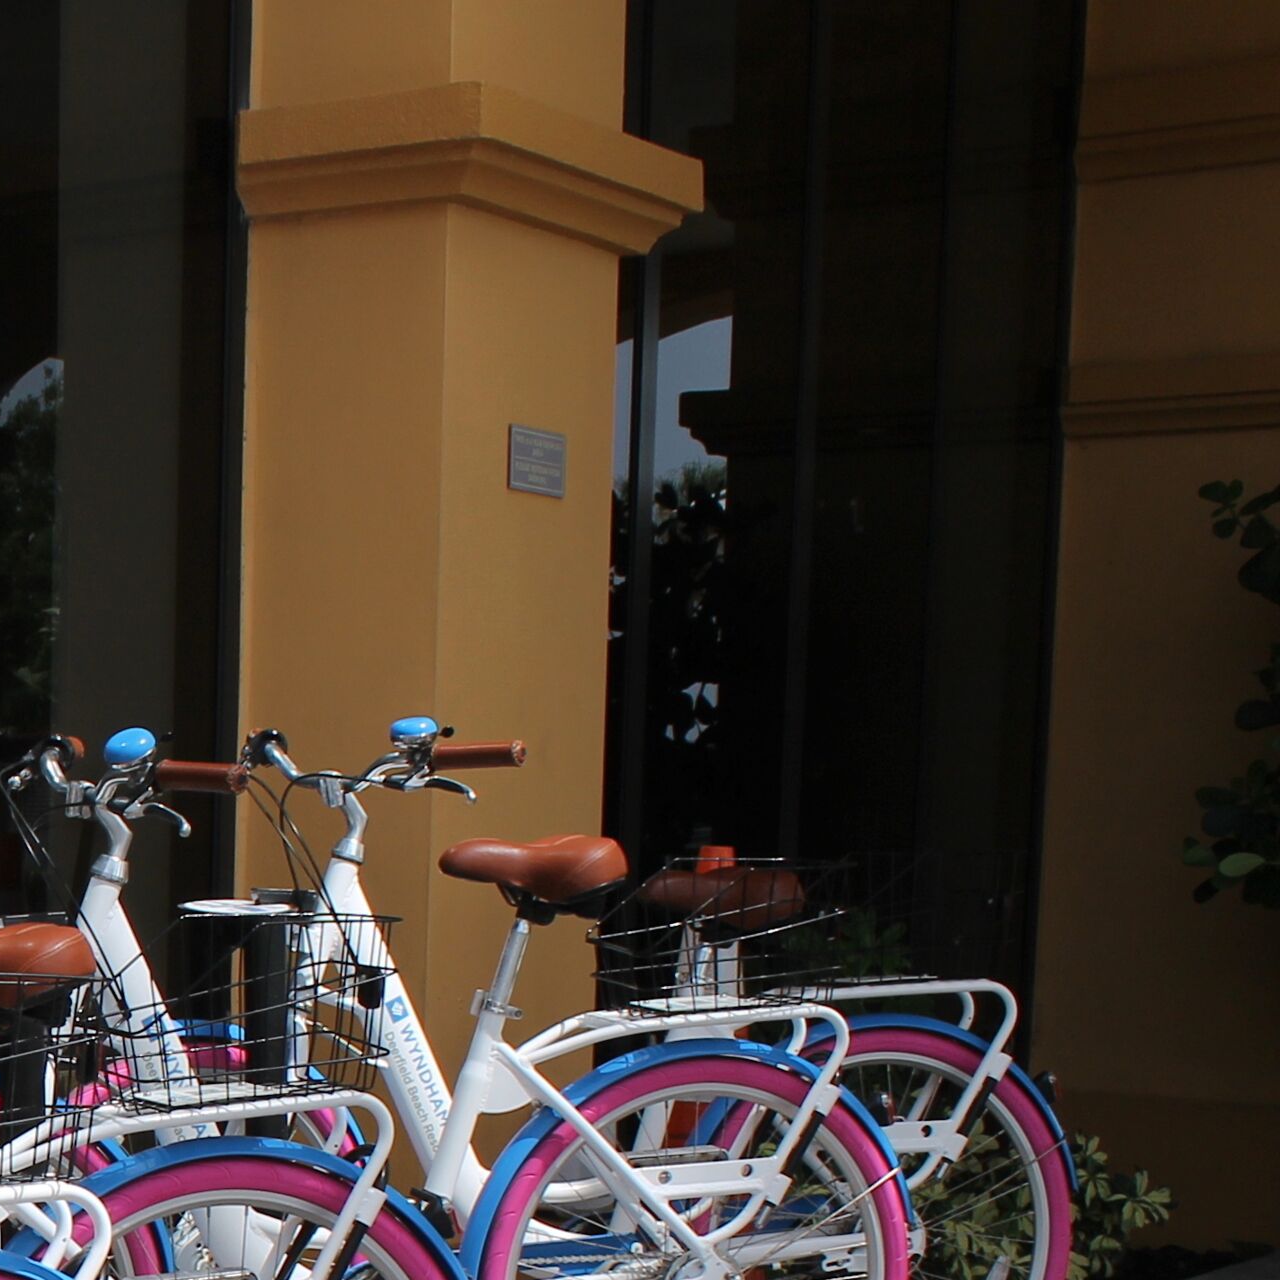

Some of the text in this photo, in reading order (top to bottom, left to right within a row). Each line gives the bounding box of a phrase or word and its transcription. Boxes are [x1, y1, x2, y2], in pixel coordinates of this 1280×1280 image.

[384, 1031, 441, 1153] Deerfield Beach Reso
[400, 1023, 449, 1127] WYNDHAM
